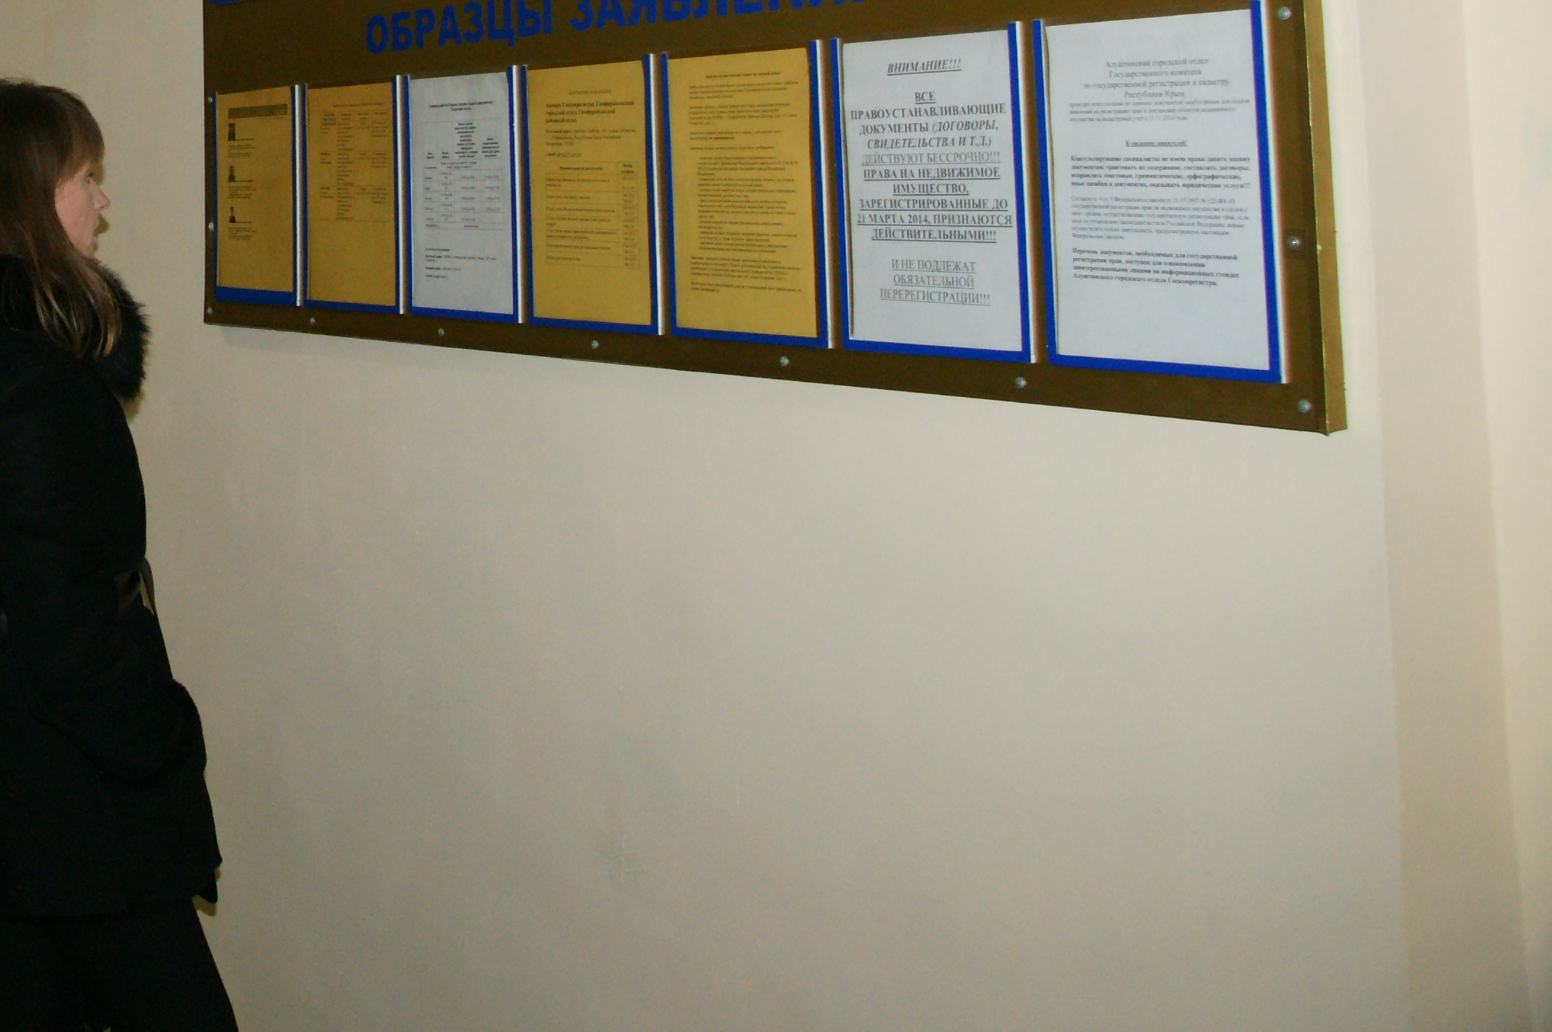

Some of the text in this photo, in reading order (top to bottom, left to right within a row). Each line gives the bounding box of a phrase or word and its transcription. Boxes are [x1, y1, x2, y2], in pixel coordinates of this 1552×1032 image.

[886, 58, 961, 74] ВНИМАНИЕ!!!
[914, 90, 935, 102] ВСЕ
[850, 102, 1006, 121] ПРАВОУСТАНАВЛИВАЮЩИЕ
[858, 122, 929, 136] ДОКУМЕНТЫ
[866, 134, 992, 150] СВИДЕТЕЛЬСТВА И Т.Д.)
[861, 149, 1001, 165] ДЕЙСТВУЮТ БЕССРОЧНО!!!
[862, 167, 1000, 180] ПРАВА НА НЕДВИЖИМОЕ
[892, 182, 969, 195] ИМУЩЕСТВО,
[858, 198, 1008, 210] ЗАРЕГИСТРИРОВАННЫЕ ДО
[868, 213, 905, 225] МАРТА
[932, 214, 1012, 226] ПРИЗНАЮТСЯ
[870, 227, 996, 241] ДЕЙСТВИТЕЛЬНЫМИ!!!
[891, 258, 976, 272] И НЕ ПОДЛЕЖАТ
[892, 272, 974, 288] ОБЯЗАТЕЛЬНОЙ
[879, 287, 991, 305] ПЕРЕРЕГИСТРАЦИИ!!!
